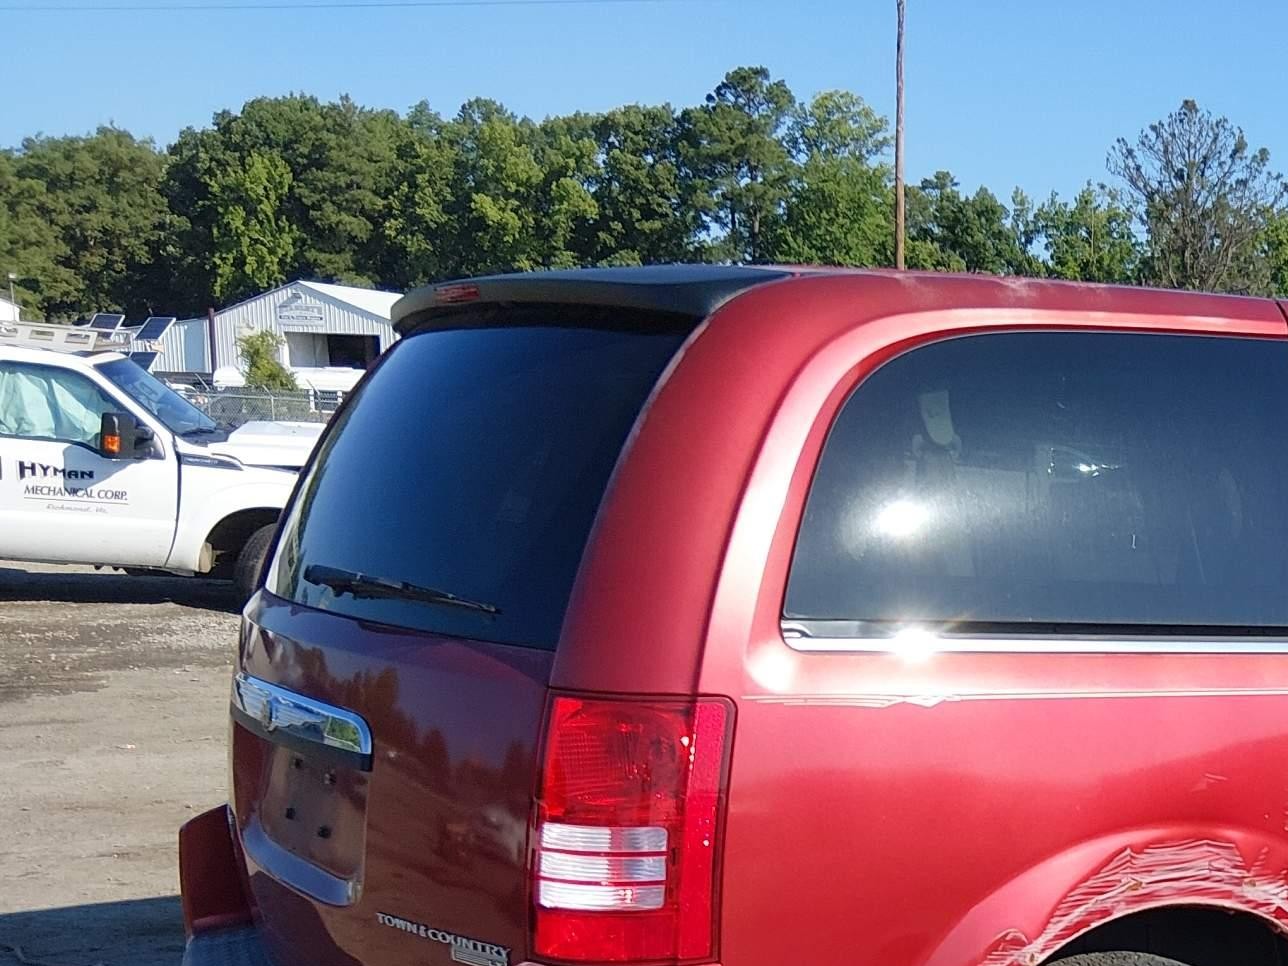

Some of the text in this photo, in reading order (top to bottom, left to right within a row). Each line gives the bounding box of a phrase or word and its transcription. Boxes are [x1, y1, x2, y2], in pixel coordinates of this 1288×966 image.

[18, 460, 95, 480] HYMAN
[24, 485, 128, 502] MECHANICAL CORP.
